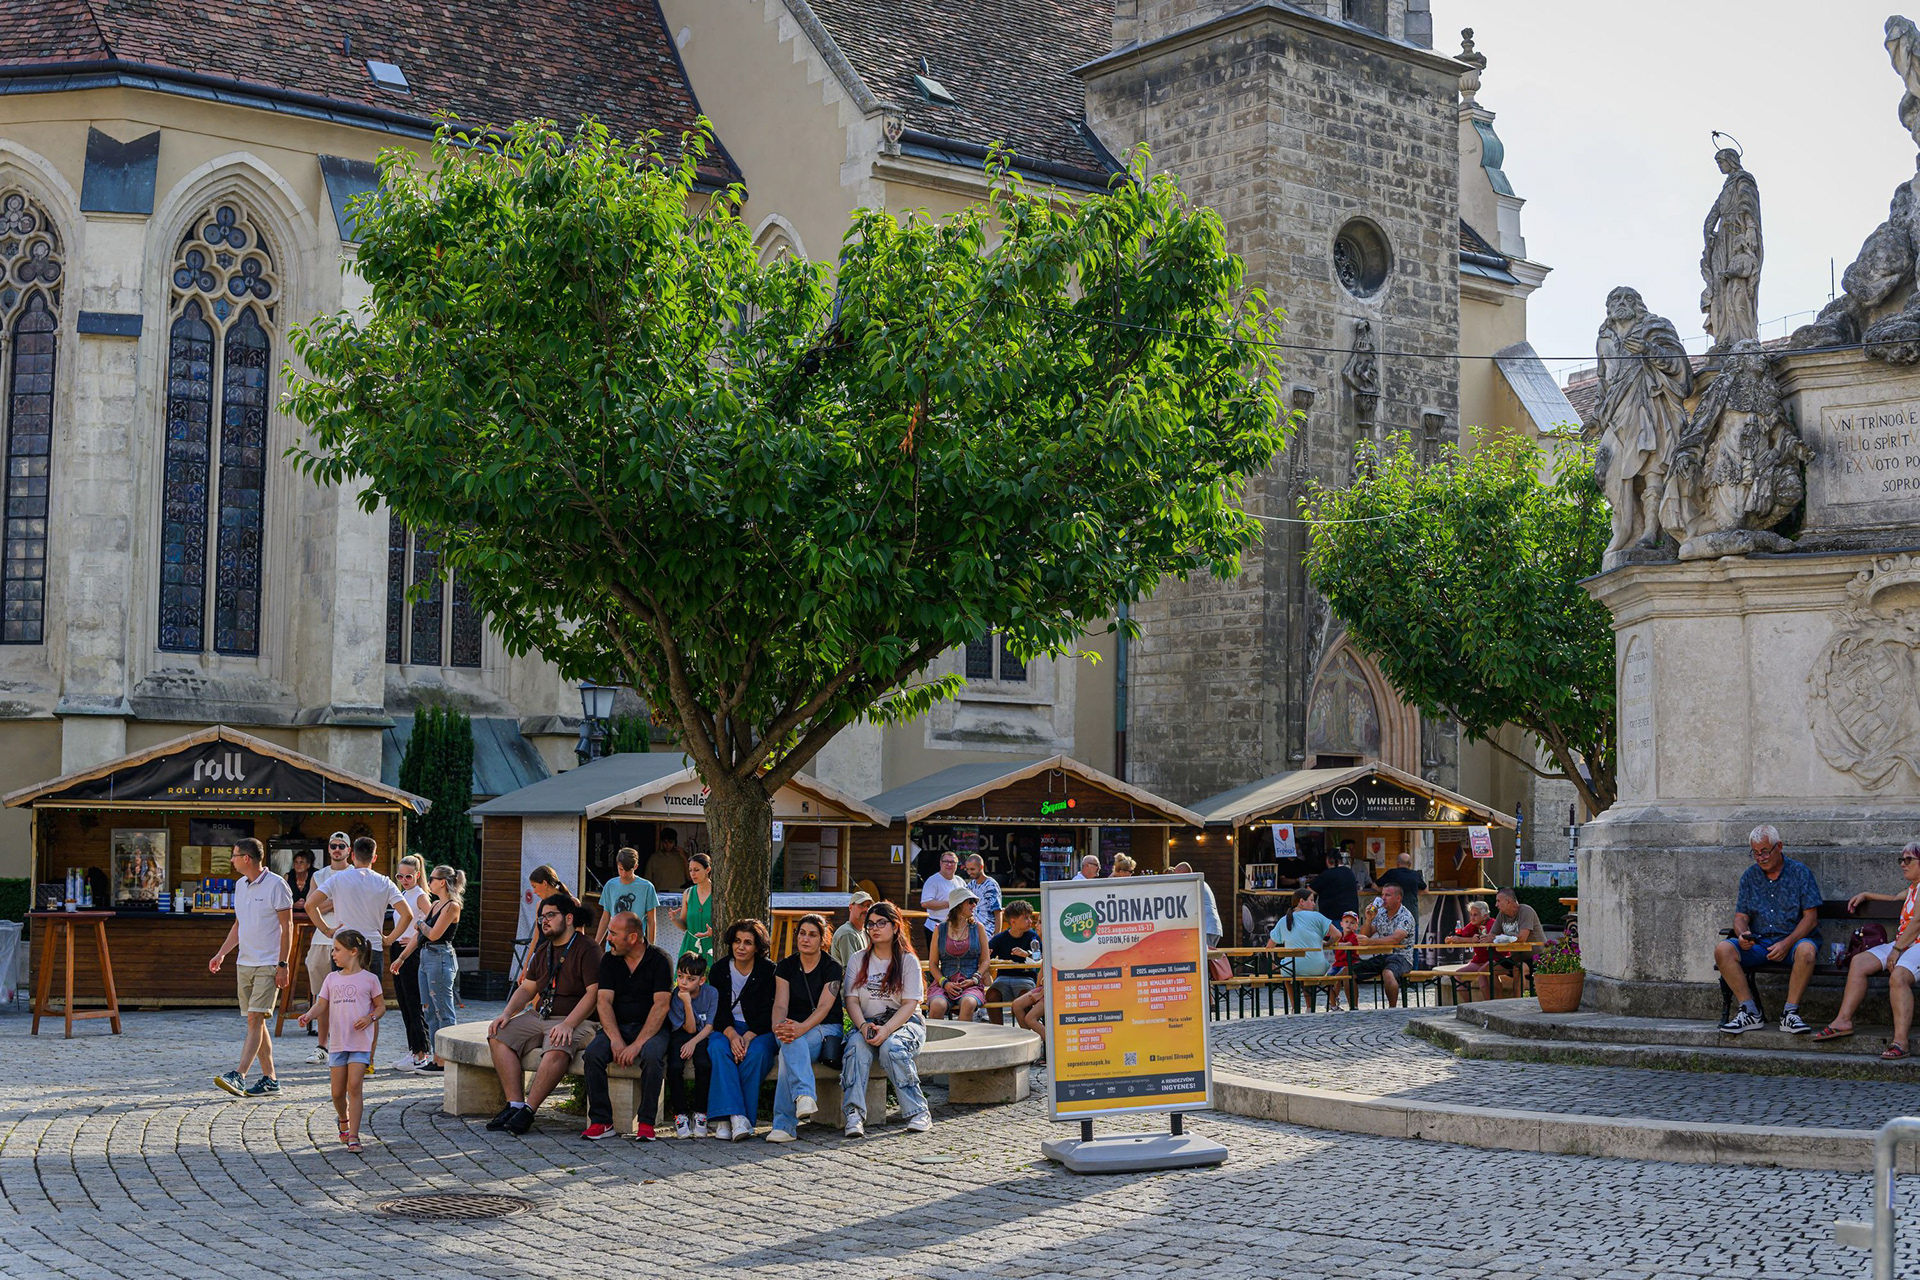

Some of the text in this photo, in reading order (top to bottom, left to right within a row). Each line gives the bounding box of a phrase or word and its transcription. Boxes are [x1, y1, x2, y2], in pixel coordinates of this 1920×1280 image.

[1846, 456, 1863, 474] EX
[1866, 455, 1899, 471] VOTO
[204, 786, 272, 794] PINCÉSZET
[664, 793, 706, 806] vincellé
[1094, 894, 1188, 924] SÖRNAPOK
[1064, 910, 1092, 926] Soproni
[1072, 918, 1094, 933] 130
[334, 984, 357, 998] NO
[1162, 1083, 1196, 1091] INGYENES!
